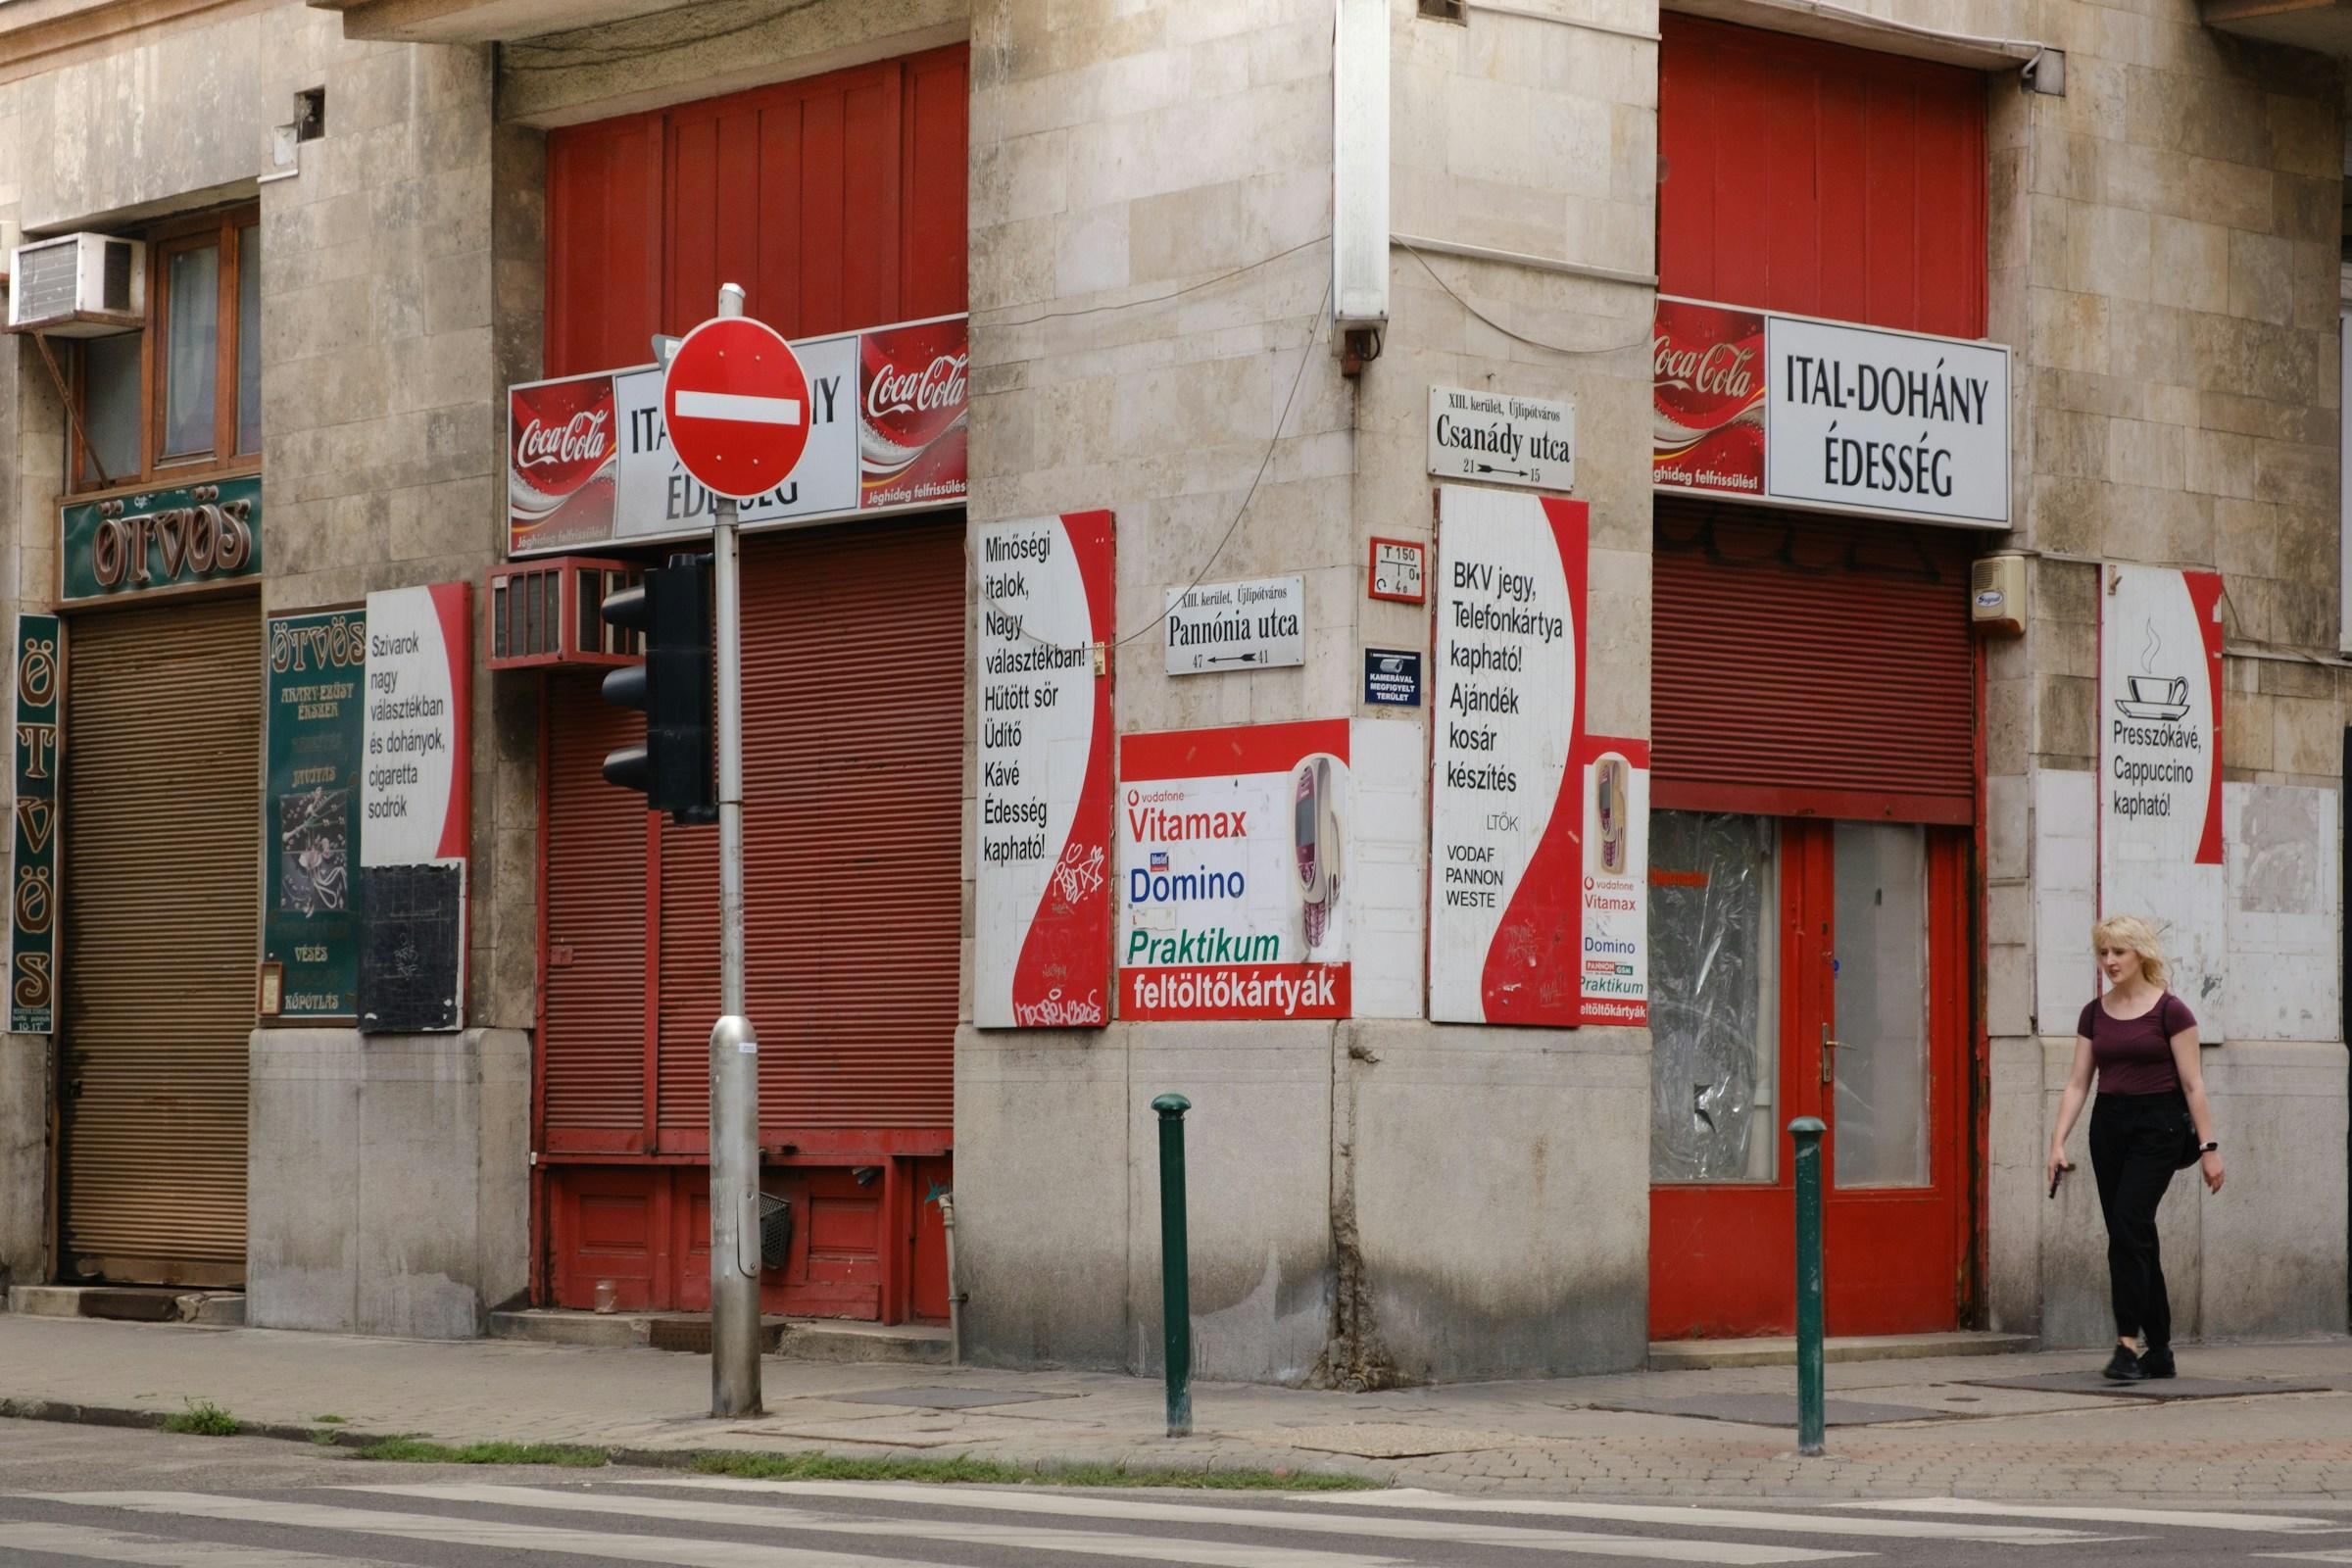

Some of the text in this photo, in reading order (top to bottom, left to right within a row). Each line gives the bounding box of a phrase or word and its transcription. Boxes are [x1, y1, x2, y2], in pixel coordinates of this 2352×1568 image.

[867, 353, 968, 418] Coca-Cola
[1787, 354, 1988, 426] ITAL-DOHÁNY
[1448, 393, 1560, 422] XIII. kerület, Újlipótváros
[517, 409, 608, 468] Coca-Cola
[1437, 414, 1570, 463] Csanády utca
[1463, 458, 1541, 482] 21 15
[1824, 419, 1953, 497] ÉDESSÉG
[1653, 466, 1758, 489] ghideg felfrissülés!
[867, 486, 911, 506] Jéghideg
[93, 484, 252, 587] ÖTVÖS
[985, 530, 1051, 564] Minőségi
[1384, 546, 1415, 562] T 150
[985, 571, 1029, 600] italok,
[1201, 590, 1233, 606] kerület,
[1238, 584, 1287, 605] Újlipótváros
[1453, 562, 1537, 602] BKV jegy,
[985, 611, 1023, 641] Nagy
[1169, 608, 1298, 647] Pannónia utca
[1452, 600, 1563, 644] Telefonkártya
[271, 616, 366, 673] ÖTVÖS
[371, 631, 419, 658] Szivarok
[985, 641, 1086, 674] választékban!
[1192, 650, 1268, 668] 47 41
[1450, 640, 1522, 674] kapható!
[370, 670, 398, 693] nagy
[1370, 673, 1413, 684] KAMERÁVAL
[1370, 682, 1415, 693] MEGFIGYELT
[370, 697, 444, 722] választékban
[985, 681, 1058, 711] Hűtött sör
[1376, 692, 1409, 702] TERÜLET
[1449, 682, 1520, 717] Ajándék
[369, 735, 383, 756] és
[386, 728, 446, 757] dohányok,
[984, 718, 1022, 749] Üdítő
[1448, 721, 1496, 752] kosár
[2113, 720, 2202, 754] Presszókávé,
[368, 763, 418, 790] cigaretta
[984, 761, 1020, 788] Kávé
[1447, 760, 1517, 793] készítés
[2114, 755, 2193, 786] Cappuccino
[368, 795, 408, 820] sodrók
[984, 793, 1047, 828] Édesség
[1142, 790, 1184, 804] vodafone
[2113, 791, 2171, 821] kapható!
[1128, 807, 1247, 843] Vitamax
[984, 833, 1045, 867] kapható!
[1447, 845, 1494, 862] VODAF
[1130, 864, 1245, 903] Domino
[1446, 867, 1503, 886] PANNON
[1446, 890, 1495, 907] WESTE
[1585, 894, 1636, 910] Vitamax
[1127, 928, 1280, 964] Praktikum
[1585, 937, 1636, 954] Domino
[1134, 968, 1336, 1015] feltöltőkártyák
[1580, 1003, 1646, 1020] eltöltőkártyák
